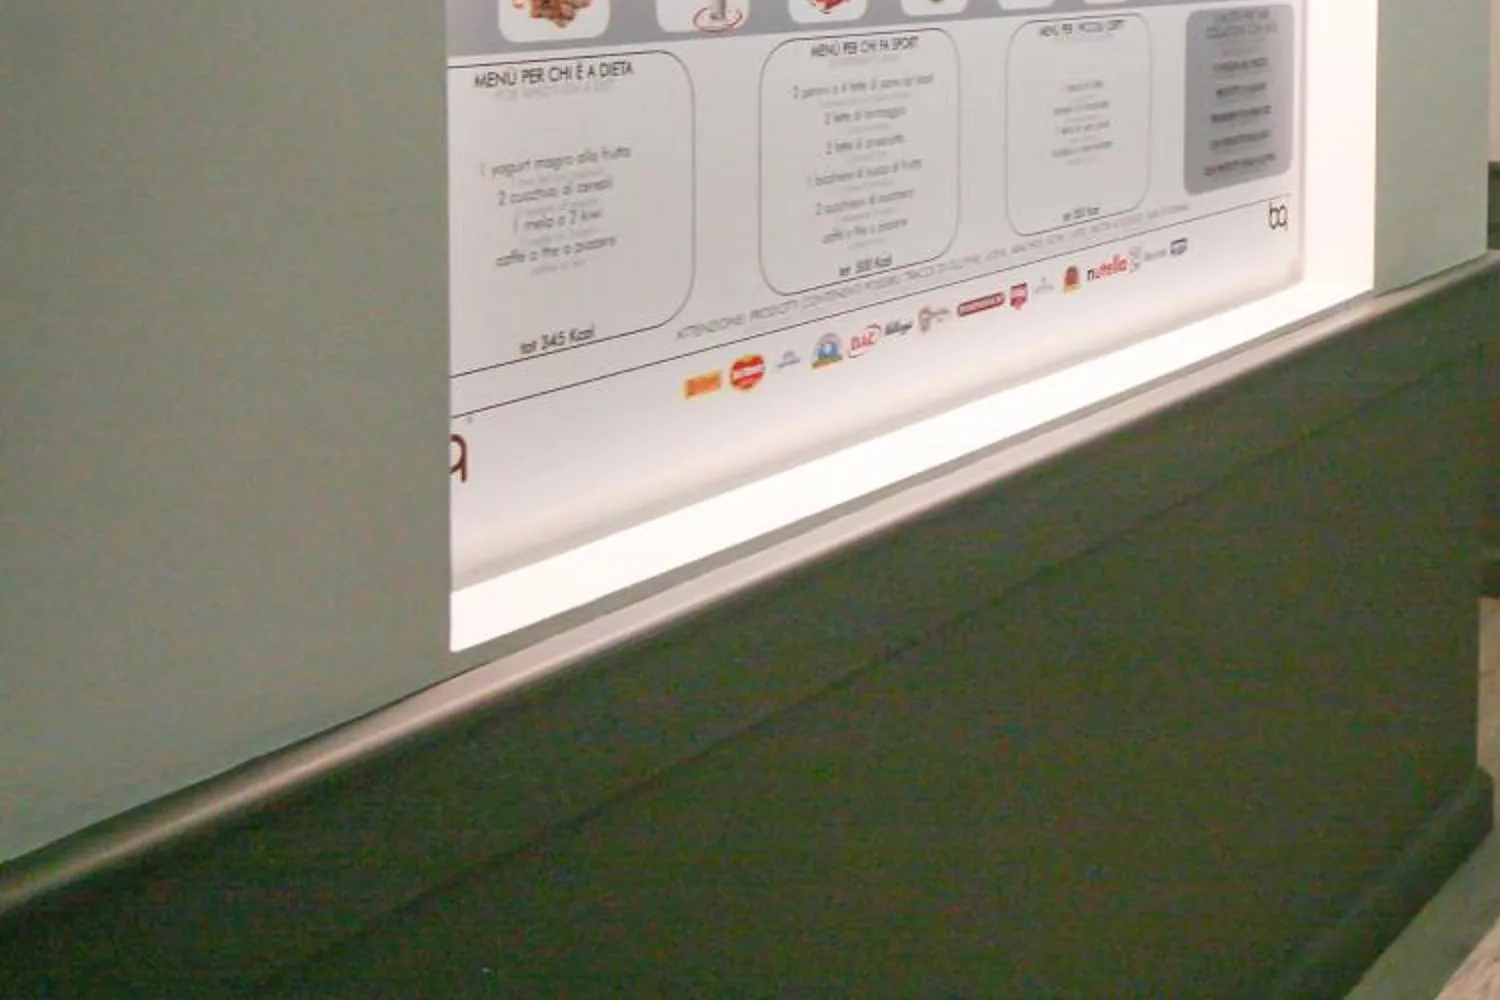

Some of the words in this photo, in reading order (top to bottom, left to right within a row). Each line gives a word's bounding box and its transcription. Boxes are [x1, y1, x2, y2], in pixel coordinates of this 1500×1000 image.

[474, 66, 517, 88] MENÙ
[521, 67, 545, 85] PER
[547, 65, 574, 82] CHI
[588, 63, 597, 79] A
[599, 60, 634, 78] DIETA
[492, 159, 531, 179] yogurt
[498, 189, 506, 206] 2
[569, 321, 595, 343] Kcal
[450, 434, 466, 482] q
